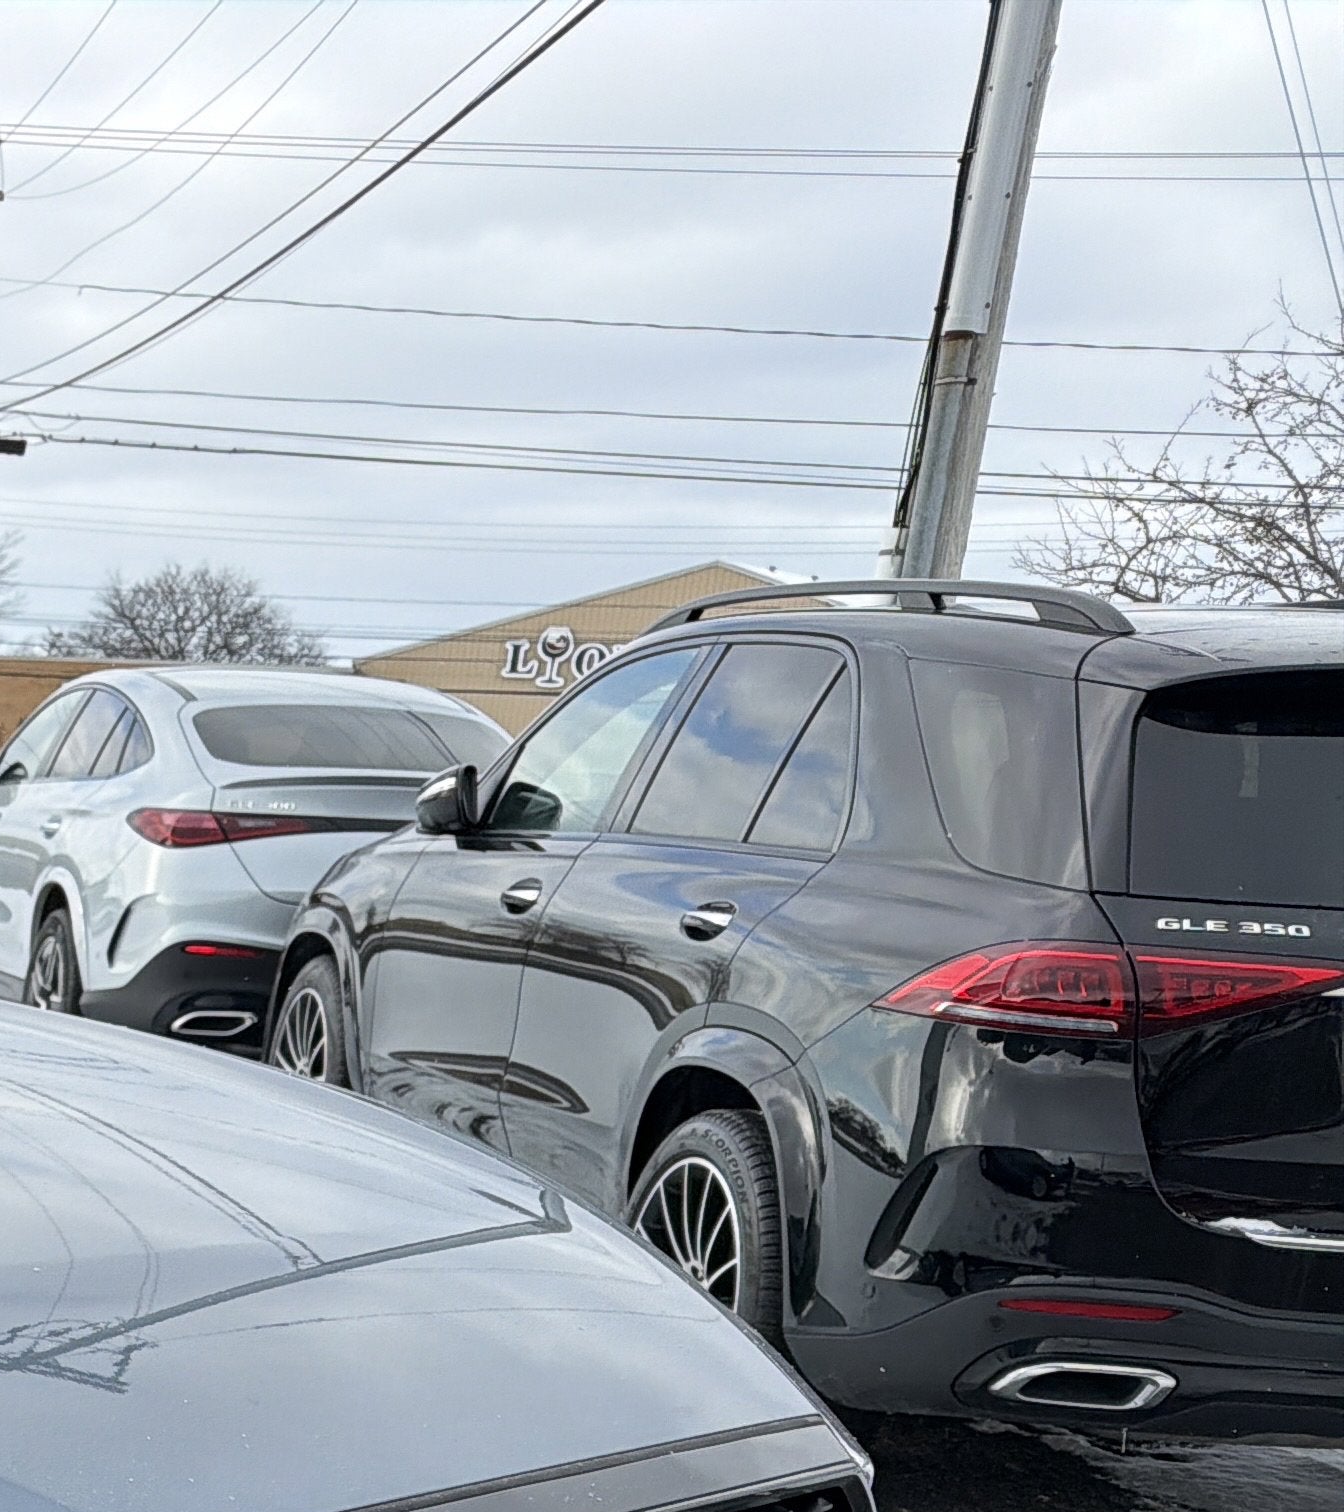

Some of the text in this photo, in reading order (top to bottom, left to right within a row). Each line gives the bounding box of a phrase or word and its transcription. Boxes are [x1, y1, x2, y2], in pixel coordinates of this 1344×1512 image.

[1156, 917, 1311, 937] GLE 350
[701, 1128, 749, 1204] SCORPION
